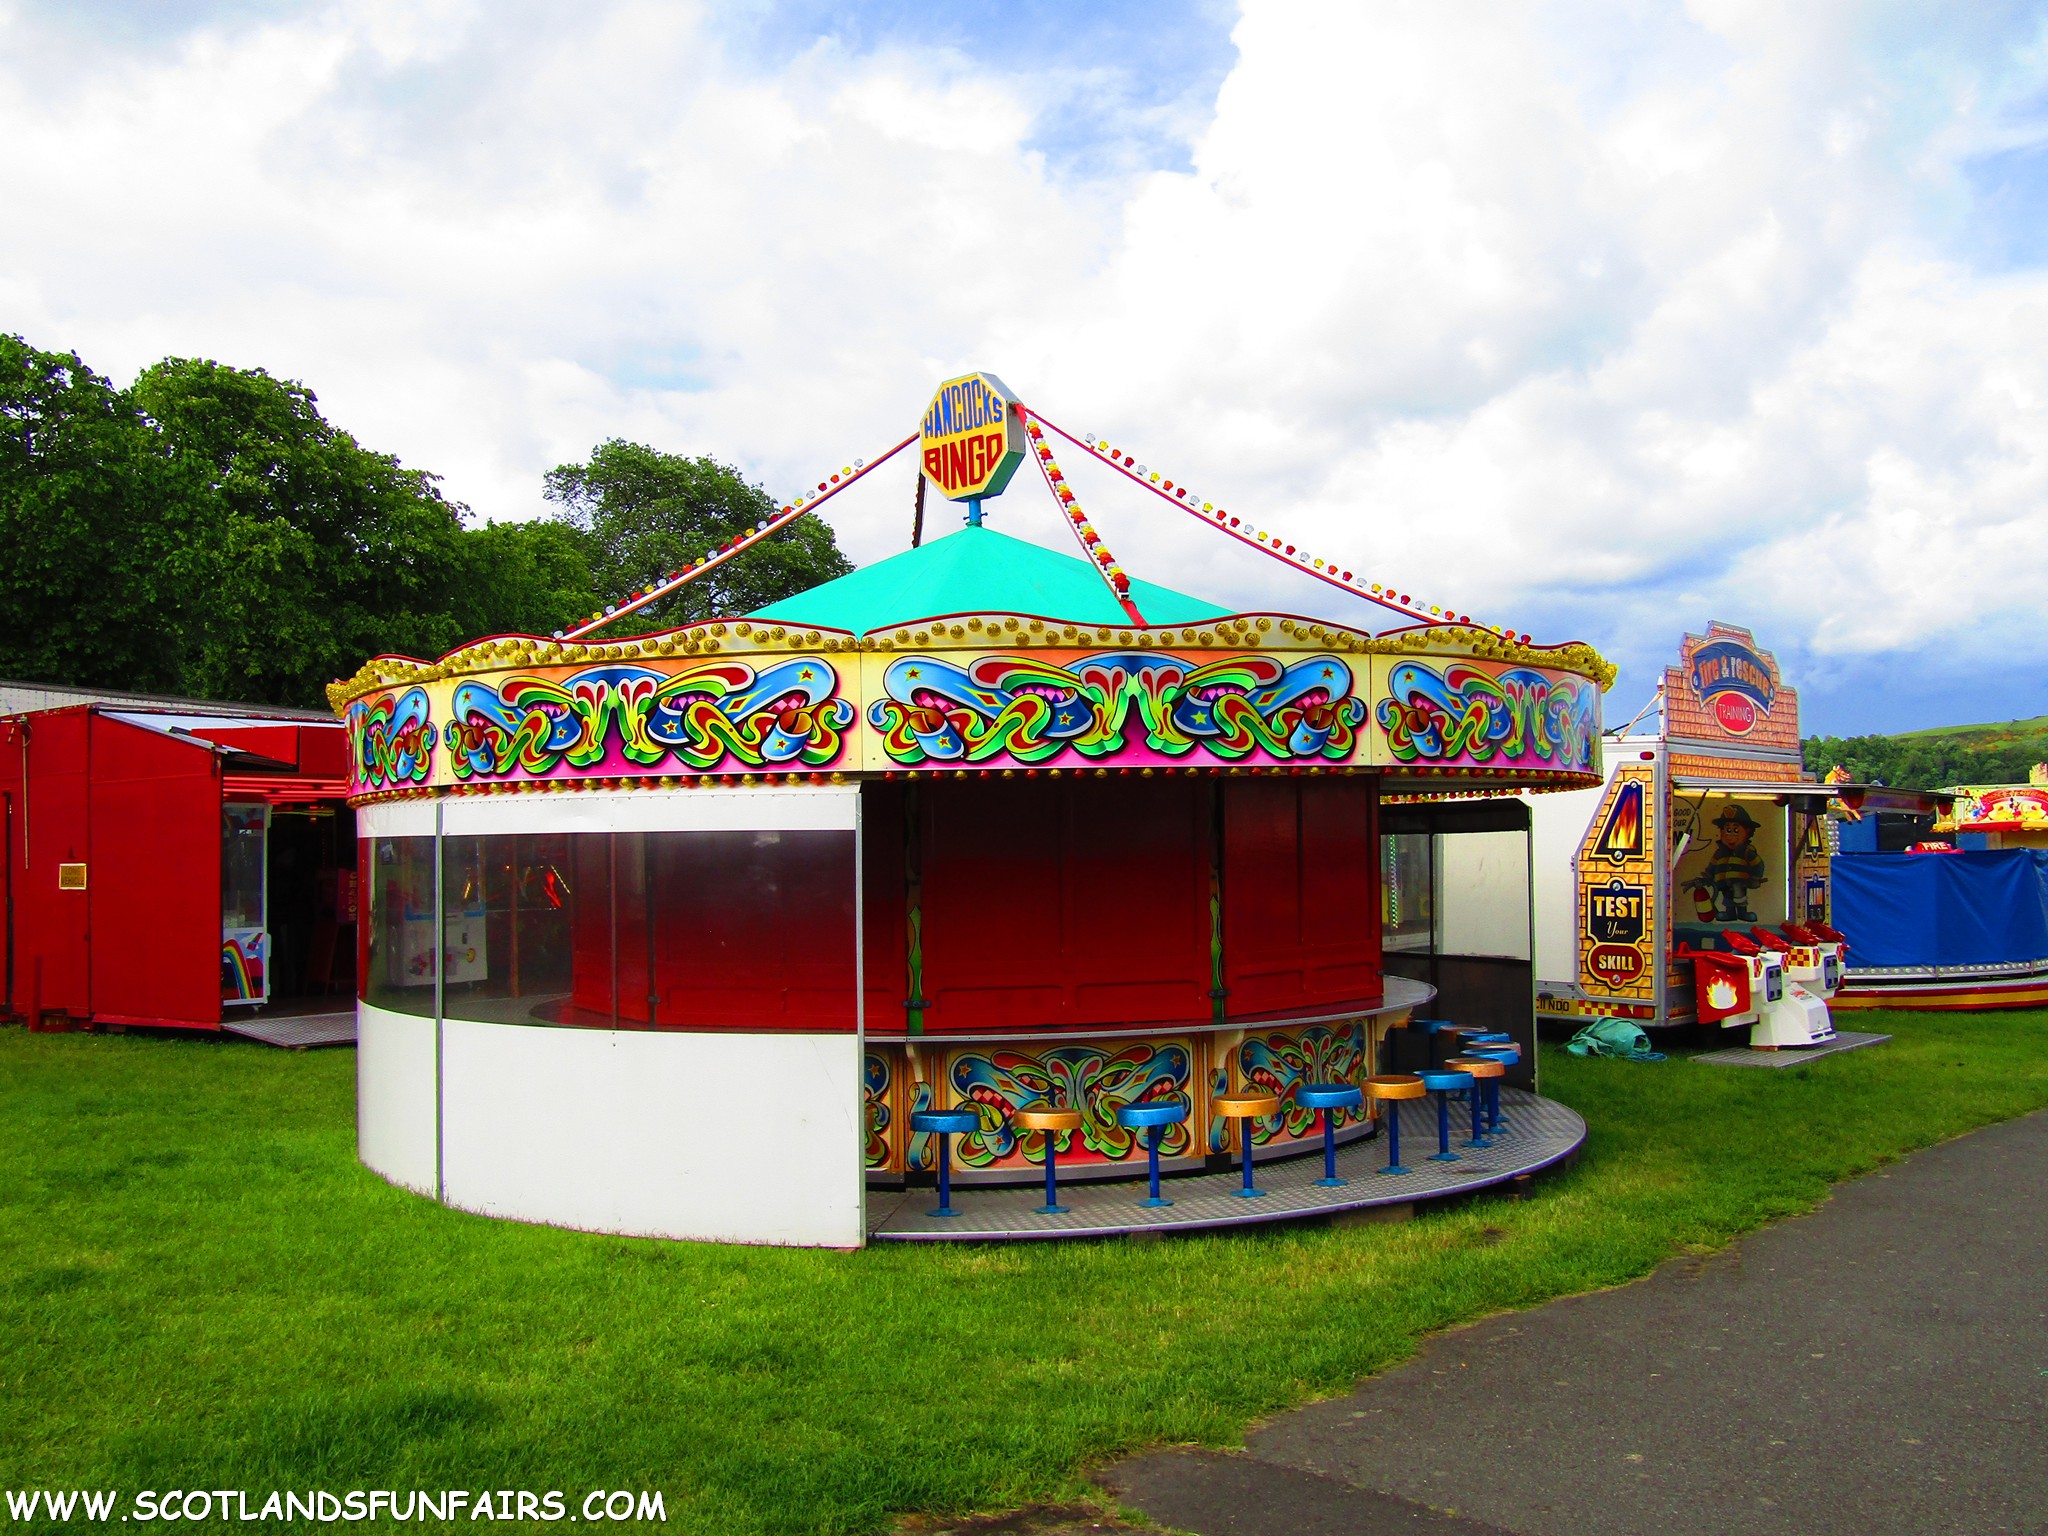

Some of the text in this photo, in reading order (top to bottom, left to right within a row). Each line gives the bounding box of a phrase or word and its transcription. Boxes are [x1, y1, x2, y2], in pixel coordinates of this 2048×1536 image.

[924, 379, 1003, 438] HANCOCKS
[924, 433, 1003, 490] BINGO
[1698, 655, 1770, 698] fire & rescue
[1718, 703, 1752, 723] TRAINING
[1921, 841, 1949, 850] FIRE
[1593, 896, 1640, 918] TEST
[1606, 920, 1629, 938] Your
[1598, 954, 1635, 971] SKILL
